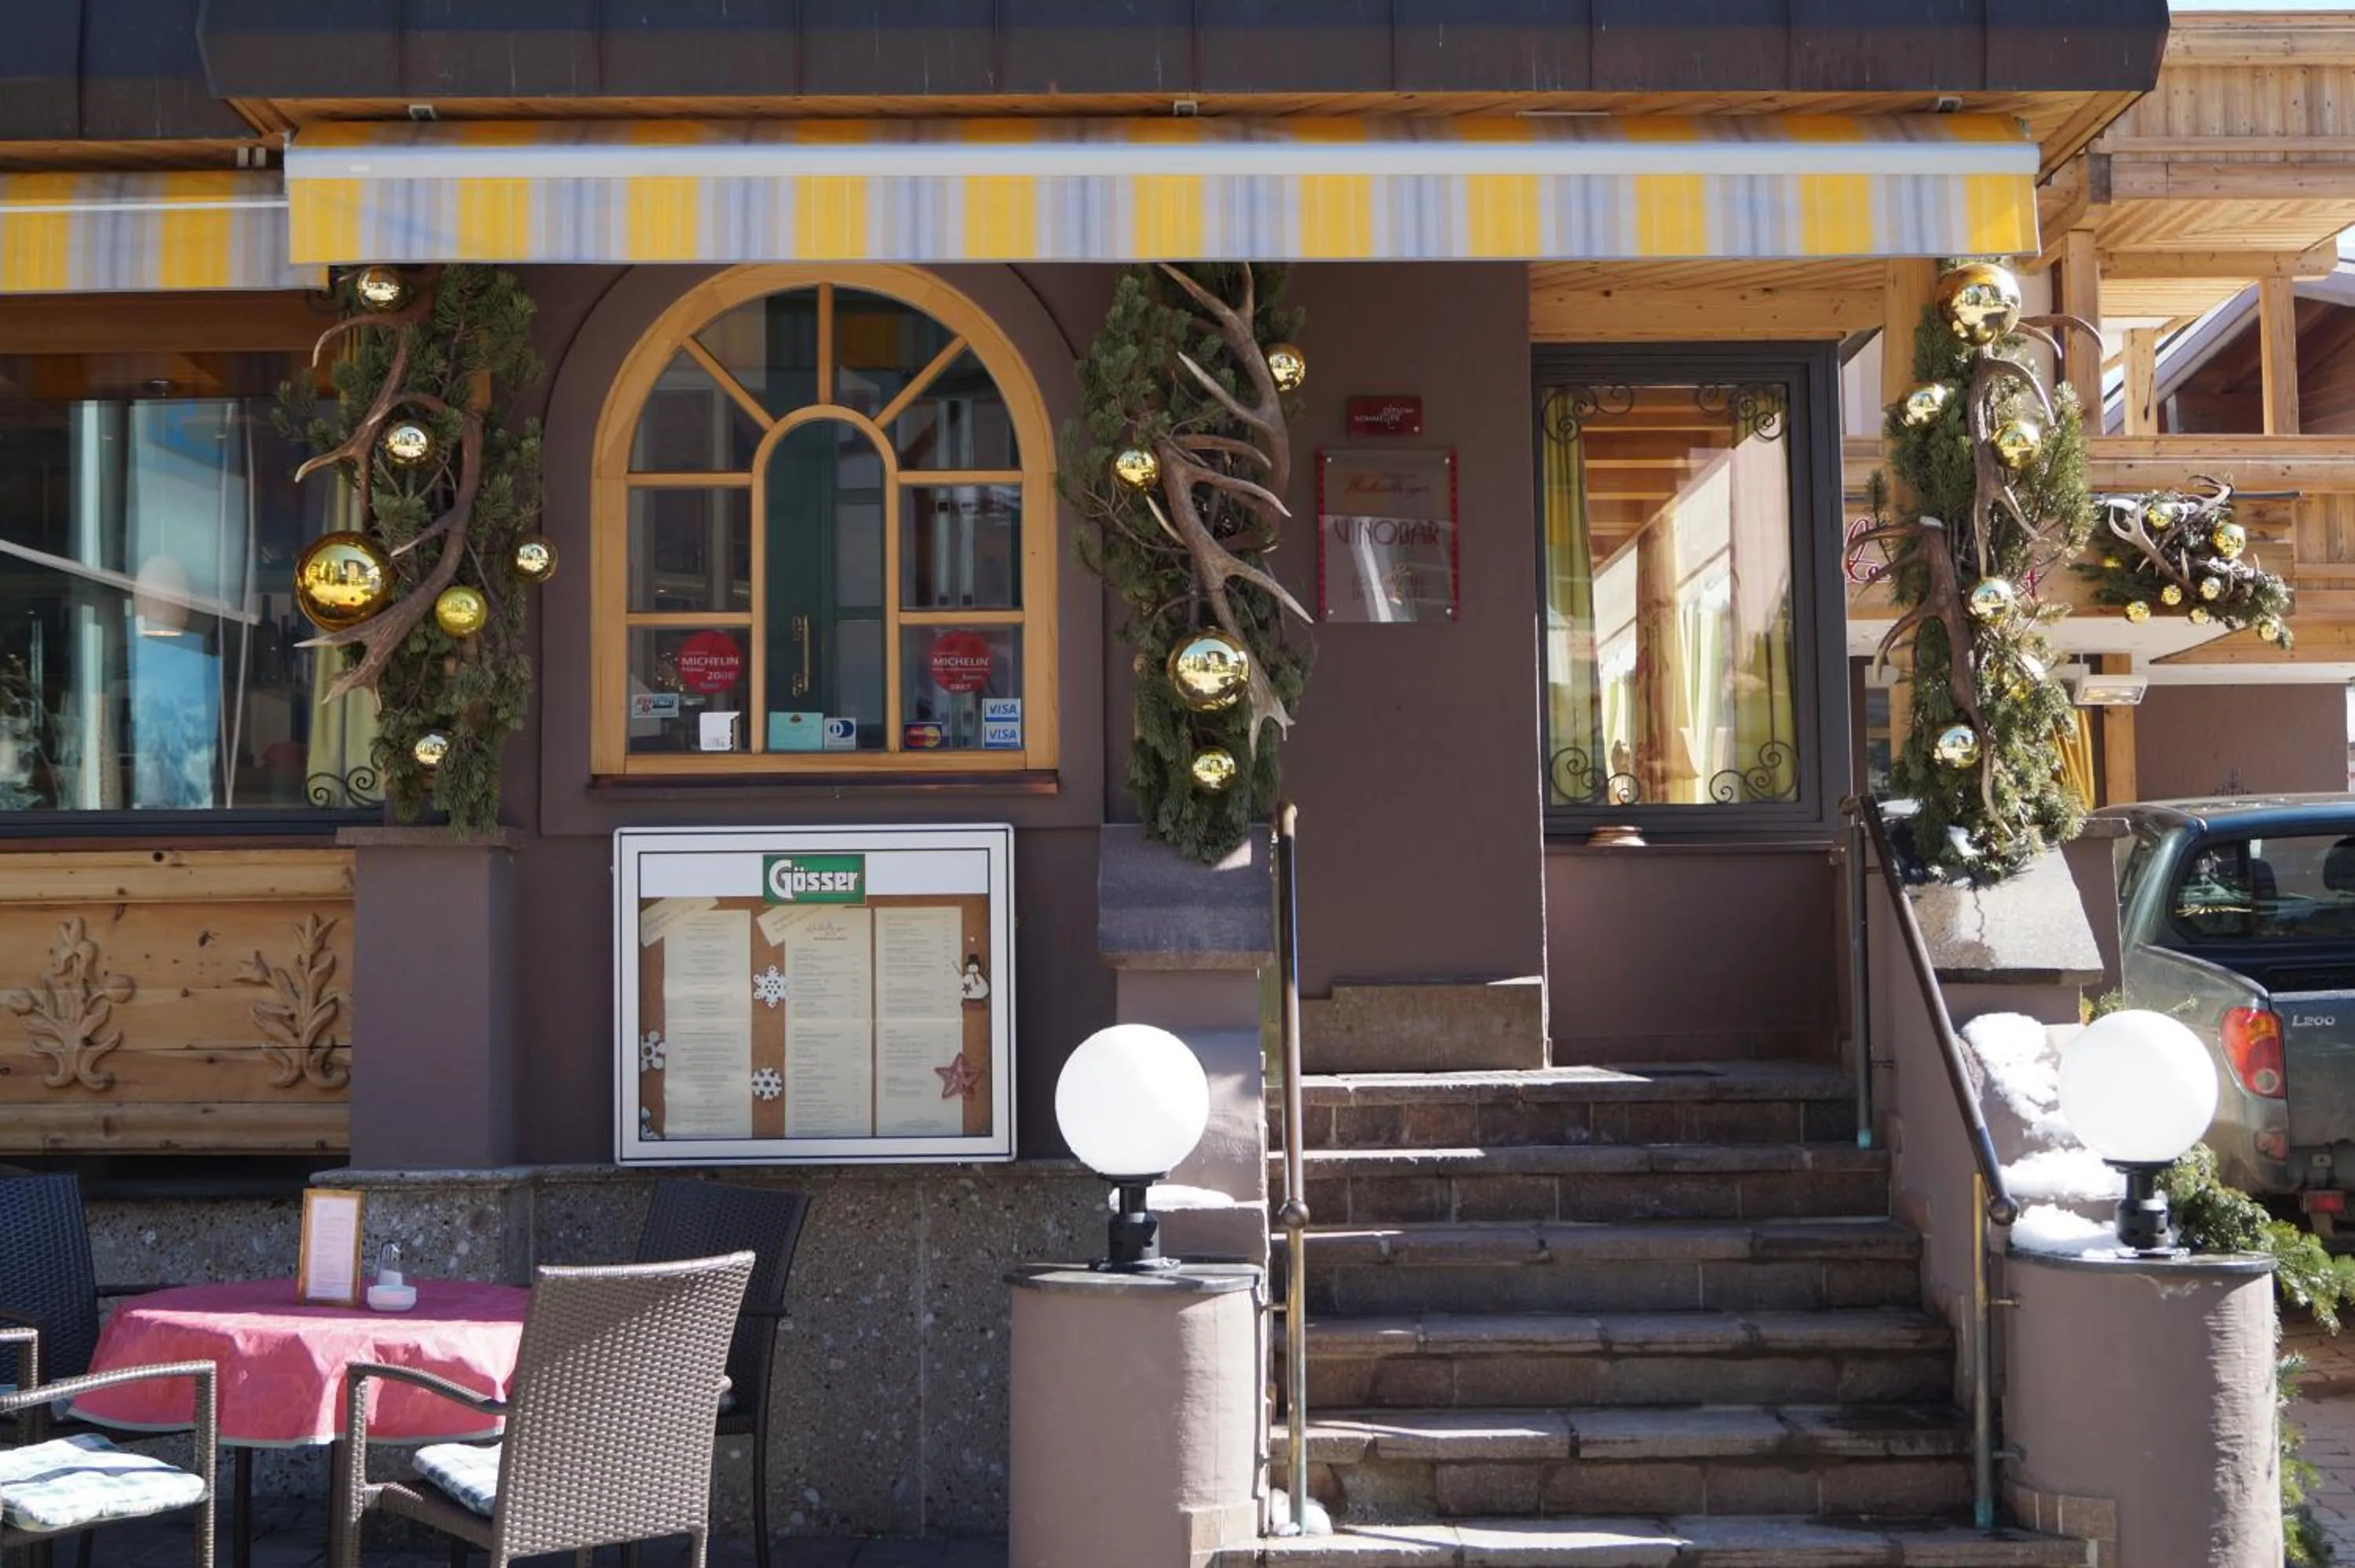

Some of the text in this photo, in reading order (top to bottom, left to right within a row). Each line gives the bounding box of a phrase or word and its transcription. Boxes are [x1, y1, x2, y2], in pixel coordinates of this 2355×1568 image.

[681, 656, 739, 666] MICHELIN
[932, 656, 989, 666] MICHELIN
[989, 703, 1017, 715] VISA
[989, 728, 1017, 740] VISA
[769, 859, 859, 900] Gösser
[2291, 1014, 2336, 1027] L200
